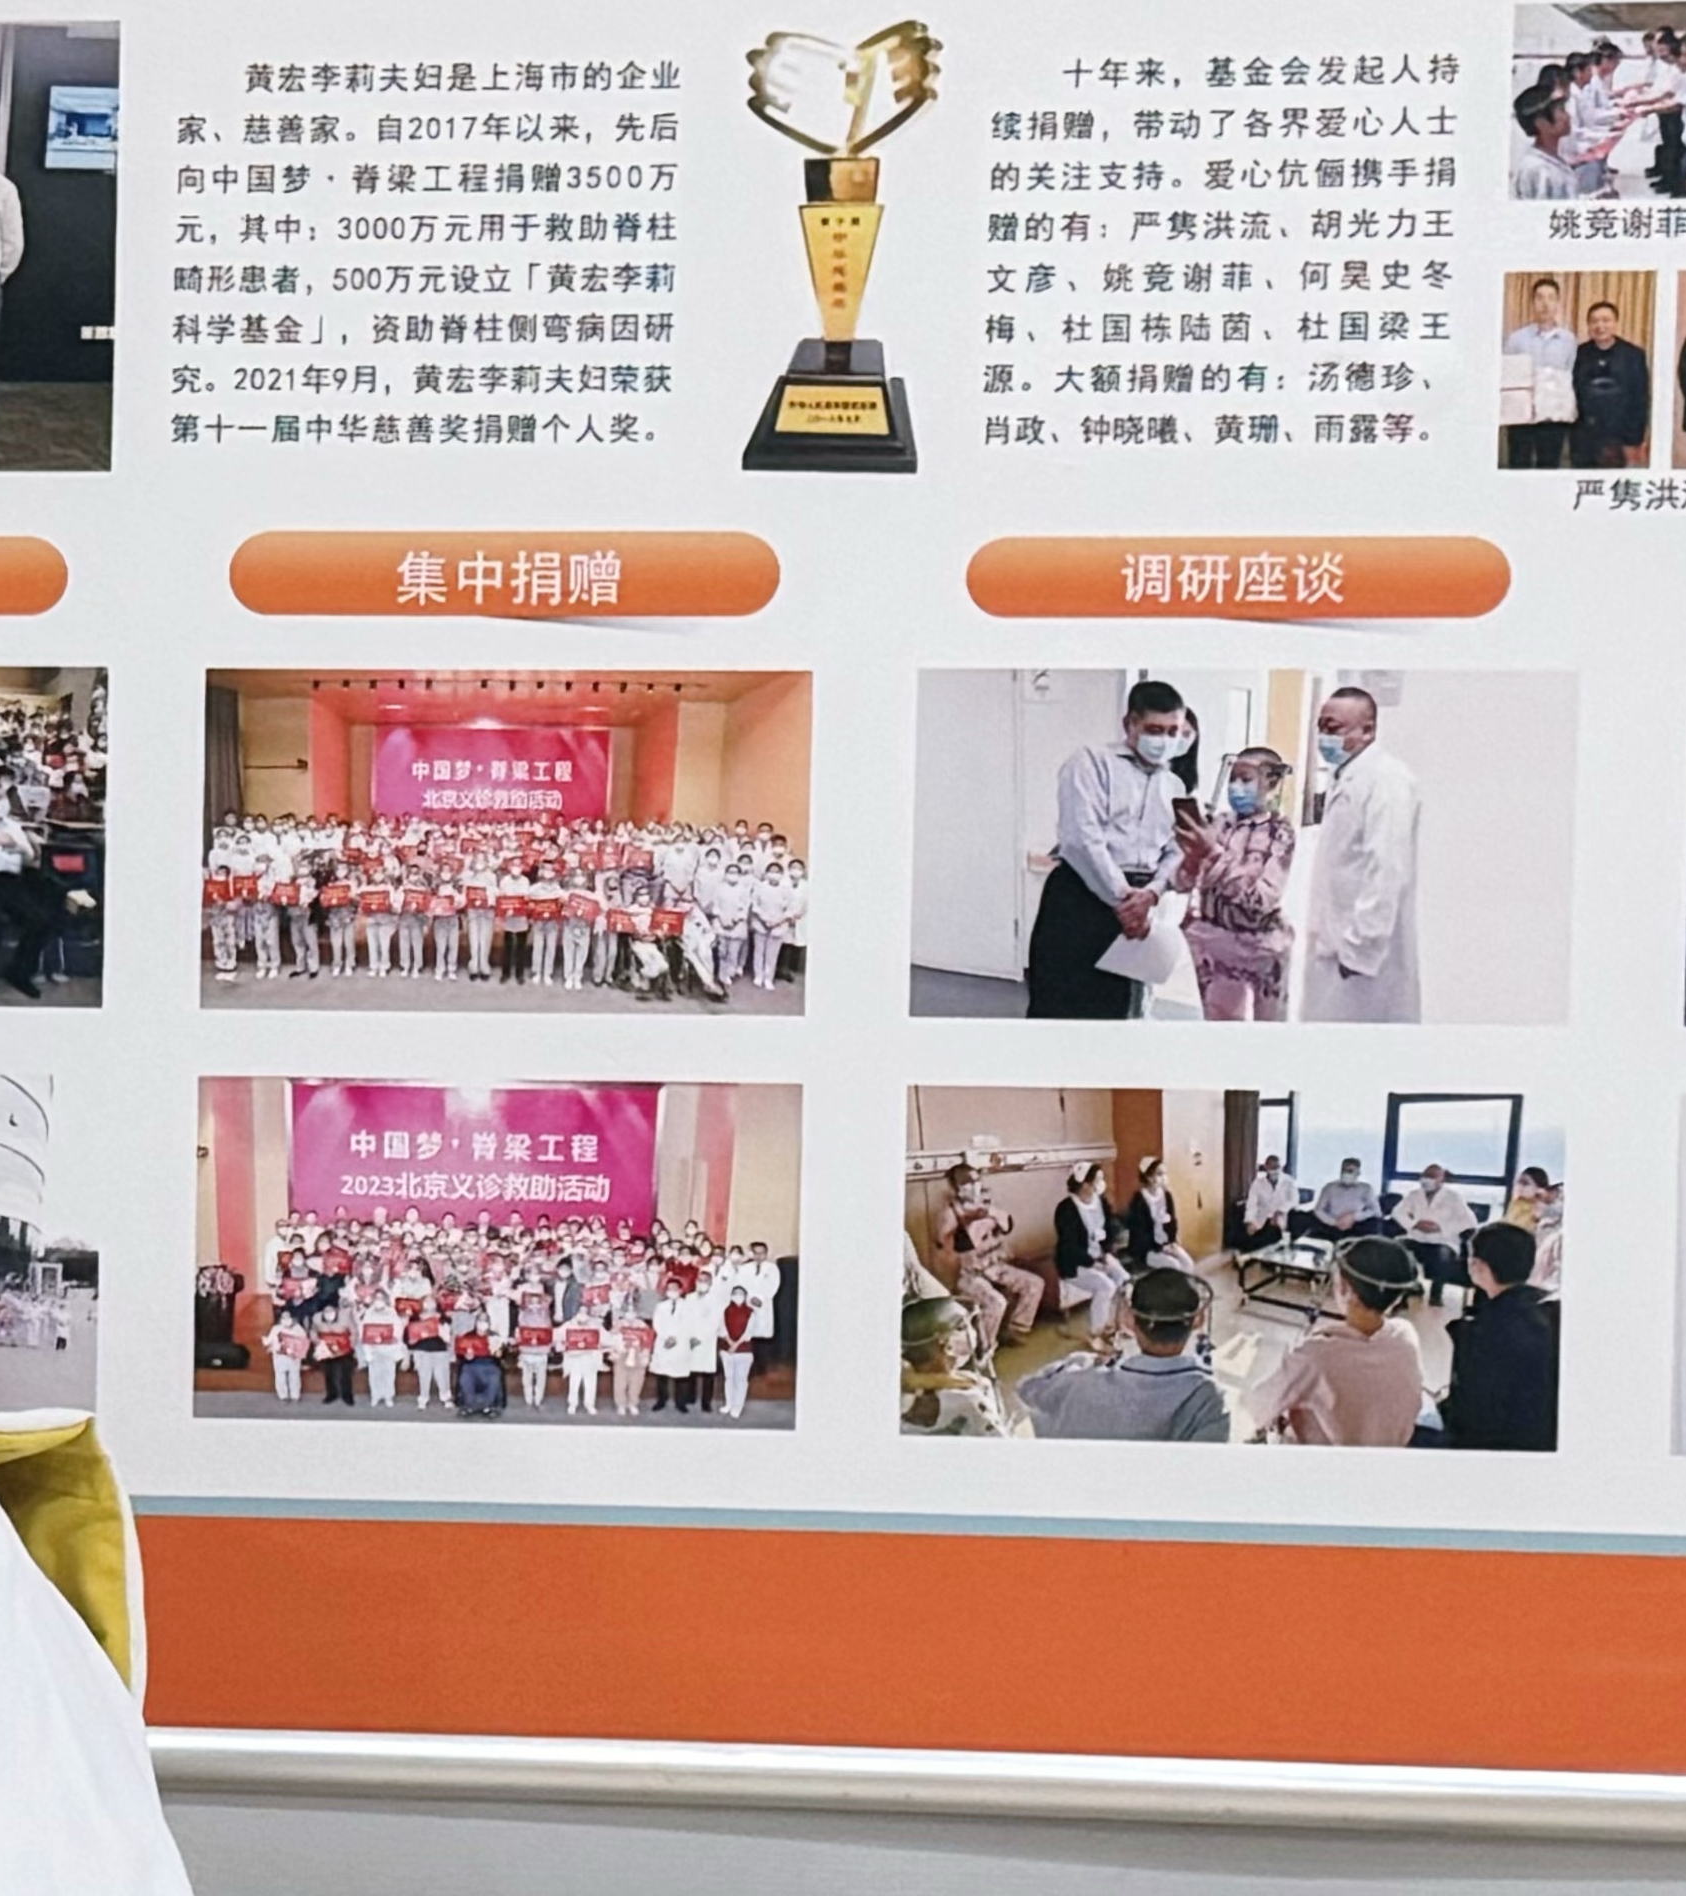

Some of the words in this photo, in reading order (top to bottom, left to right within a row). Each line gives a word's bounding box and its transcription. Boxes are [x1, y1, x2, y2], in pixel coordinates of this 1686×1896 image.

[244, 62, 682, 94] 黄宏李莉夫妇是上海市的企业
[1063, 55, 1460, 89] 十年来，基金会发起人持
[990, 108, 1458, 142] 续捐赠，带动了各界爱心人士
[989, 158, 1457, 192] 的关注支持。爱心伉俪携手捐
[169, 414, 659, 447] 第十一届中华慈善奖捐赠个人奖。
[1573, 478, 1686, 513] 严隽洪
[396, 549, 623, 608] 集中捐赠
[1121, 551, 1346, 605] 调研座谈
[349, 1129, 600, 1164] 中国梦·脊梁工程
[340, 1172, 611, 1204] 2023北京义诊救助活动
